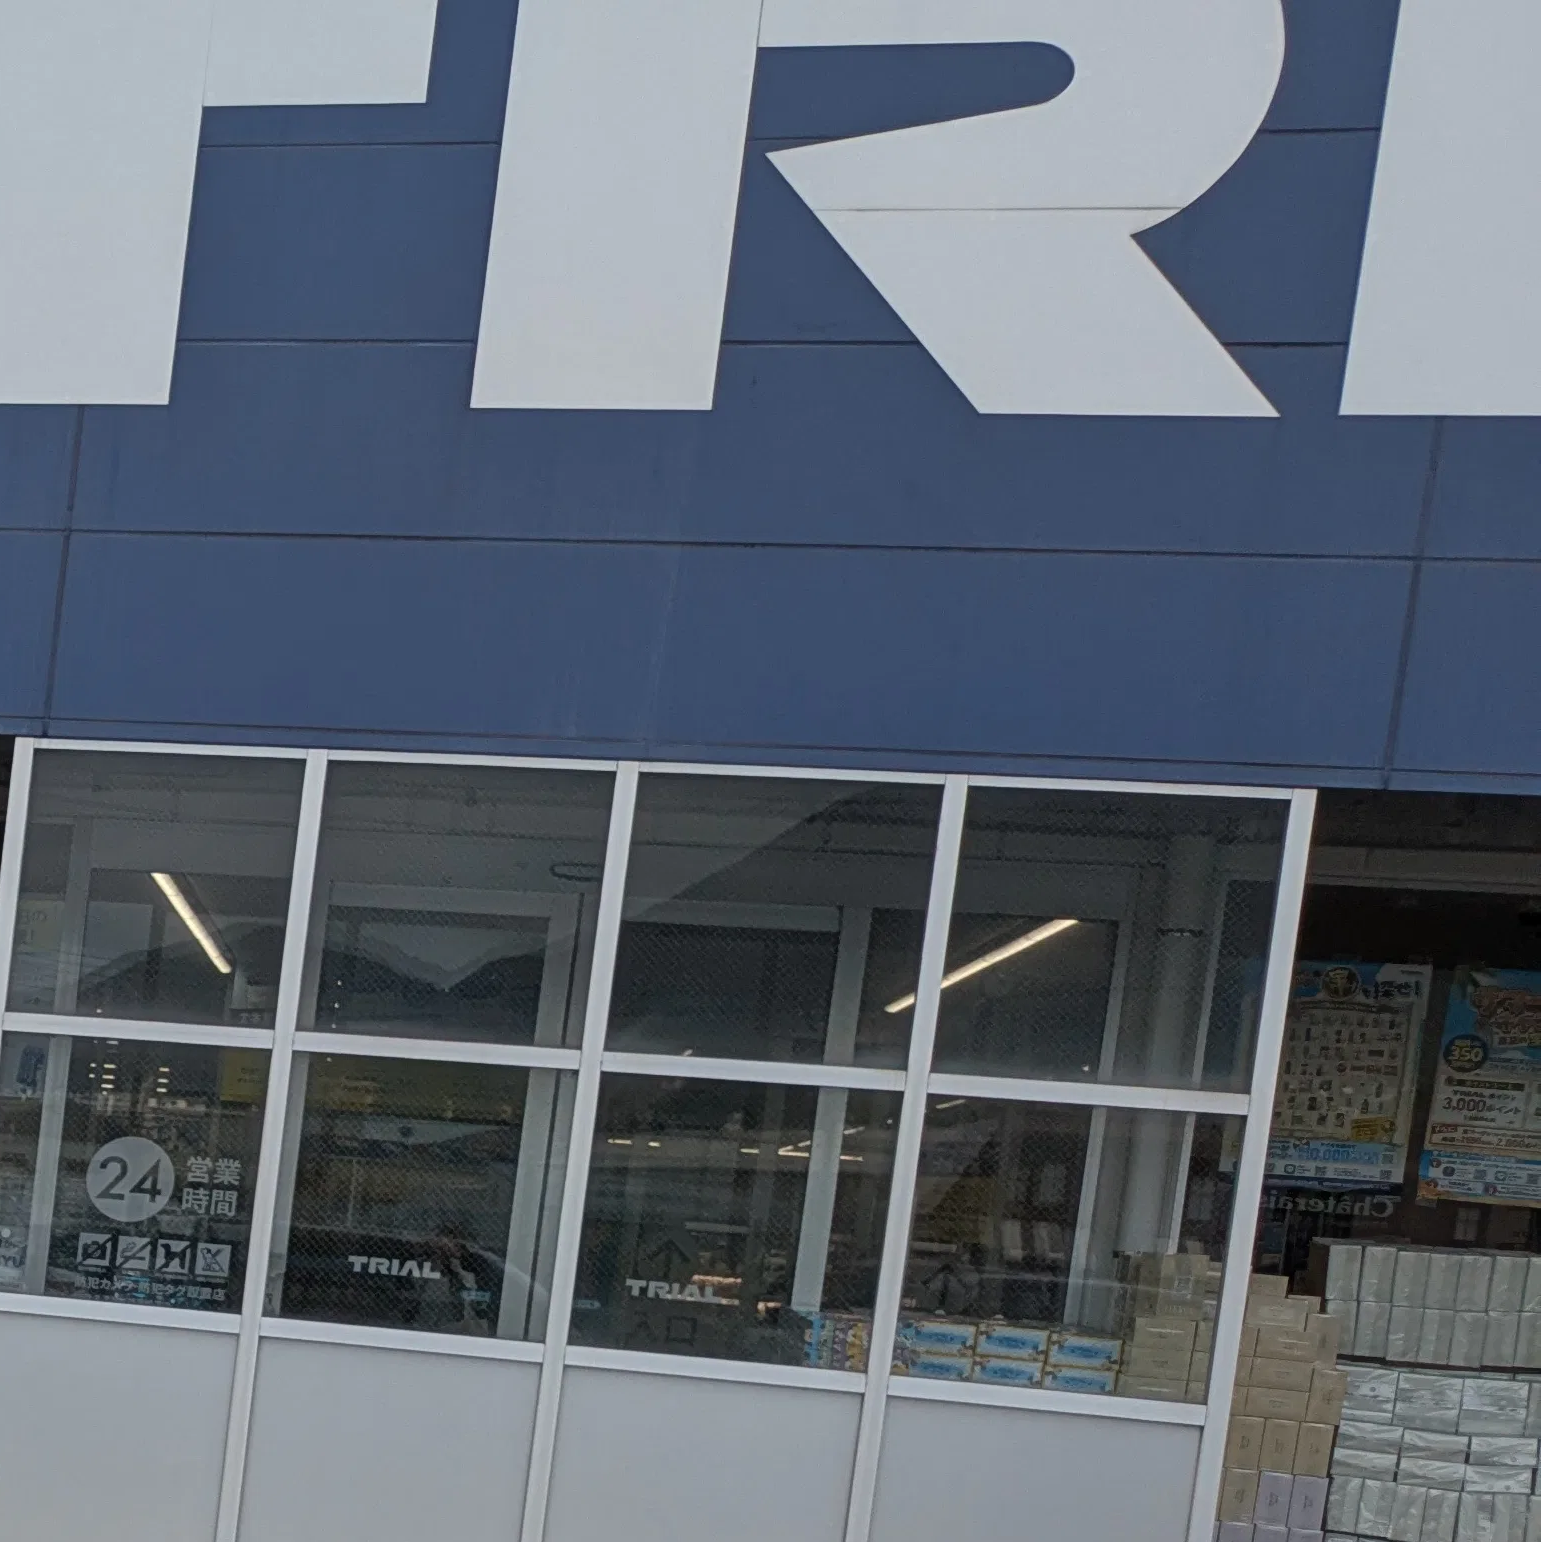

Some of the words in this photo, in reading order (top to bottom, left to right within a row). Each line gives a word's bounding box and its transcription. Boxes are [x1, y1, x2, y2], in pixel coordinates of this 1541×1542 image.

[96, 1155, 162, 1203] 24
[186, 1155, 242, 1187] 営業
[181, 1187, 238, 1217] 時間
[347, 1255, 441, 1279] TRIAL
[625, 1278, 723, 1304] TRIAL
